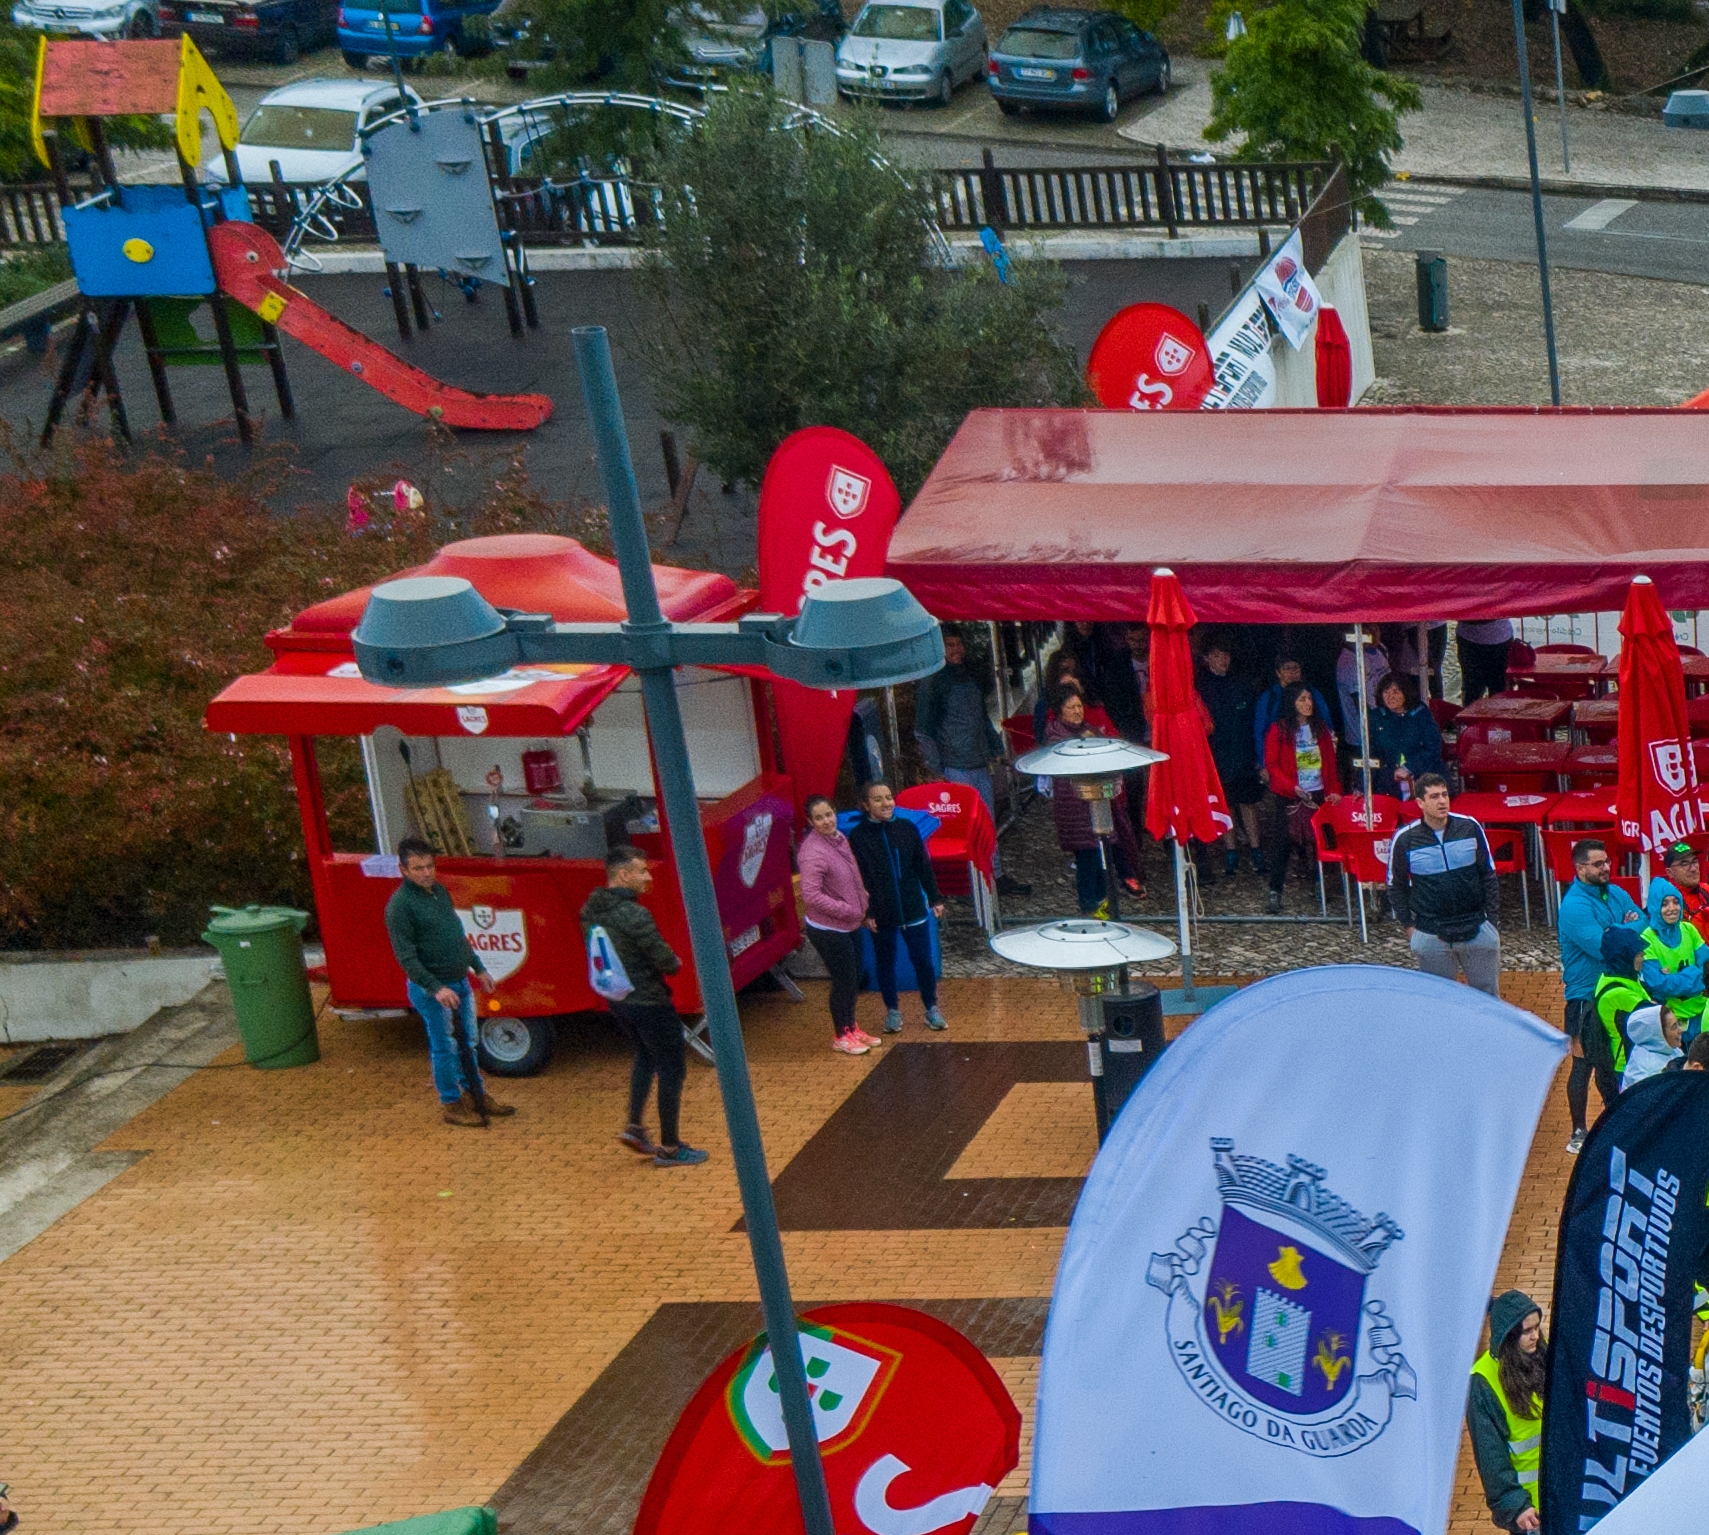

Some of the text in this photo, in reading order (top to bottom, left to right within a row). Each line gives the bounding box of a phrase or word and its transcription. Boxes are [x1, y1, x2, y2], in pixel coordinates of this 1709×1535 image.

[928, 801, 963, 815] SAGRES
[466, 931, 523, 953] AGRES
[1634, 1166, 1681, 1359] DESPORTIVOS
[1172, 1338, 1382, 1457] SANTIAGO DA GUARDA
